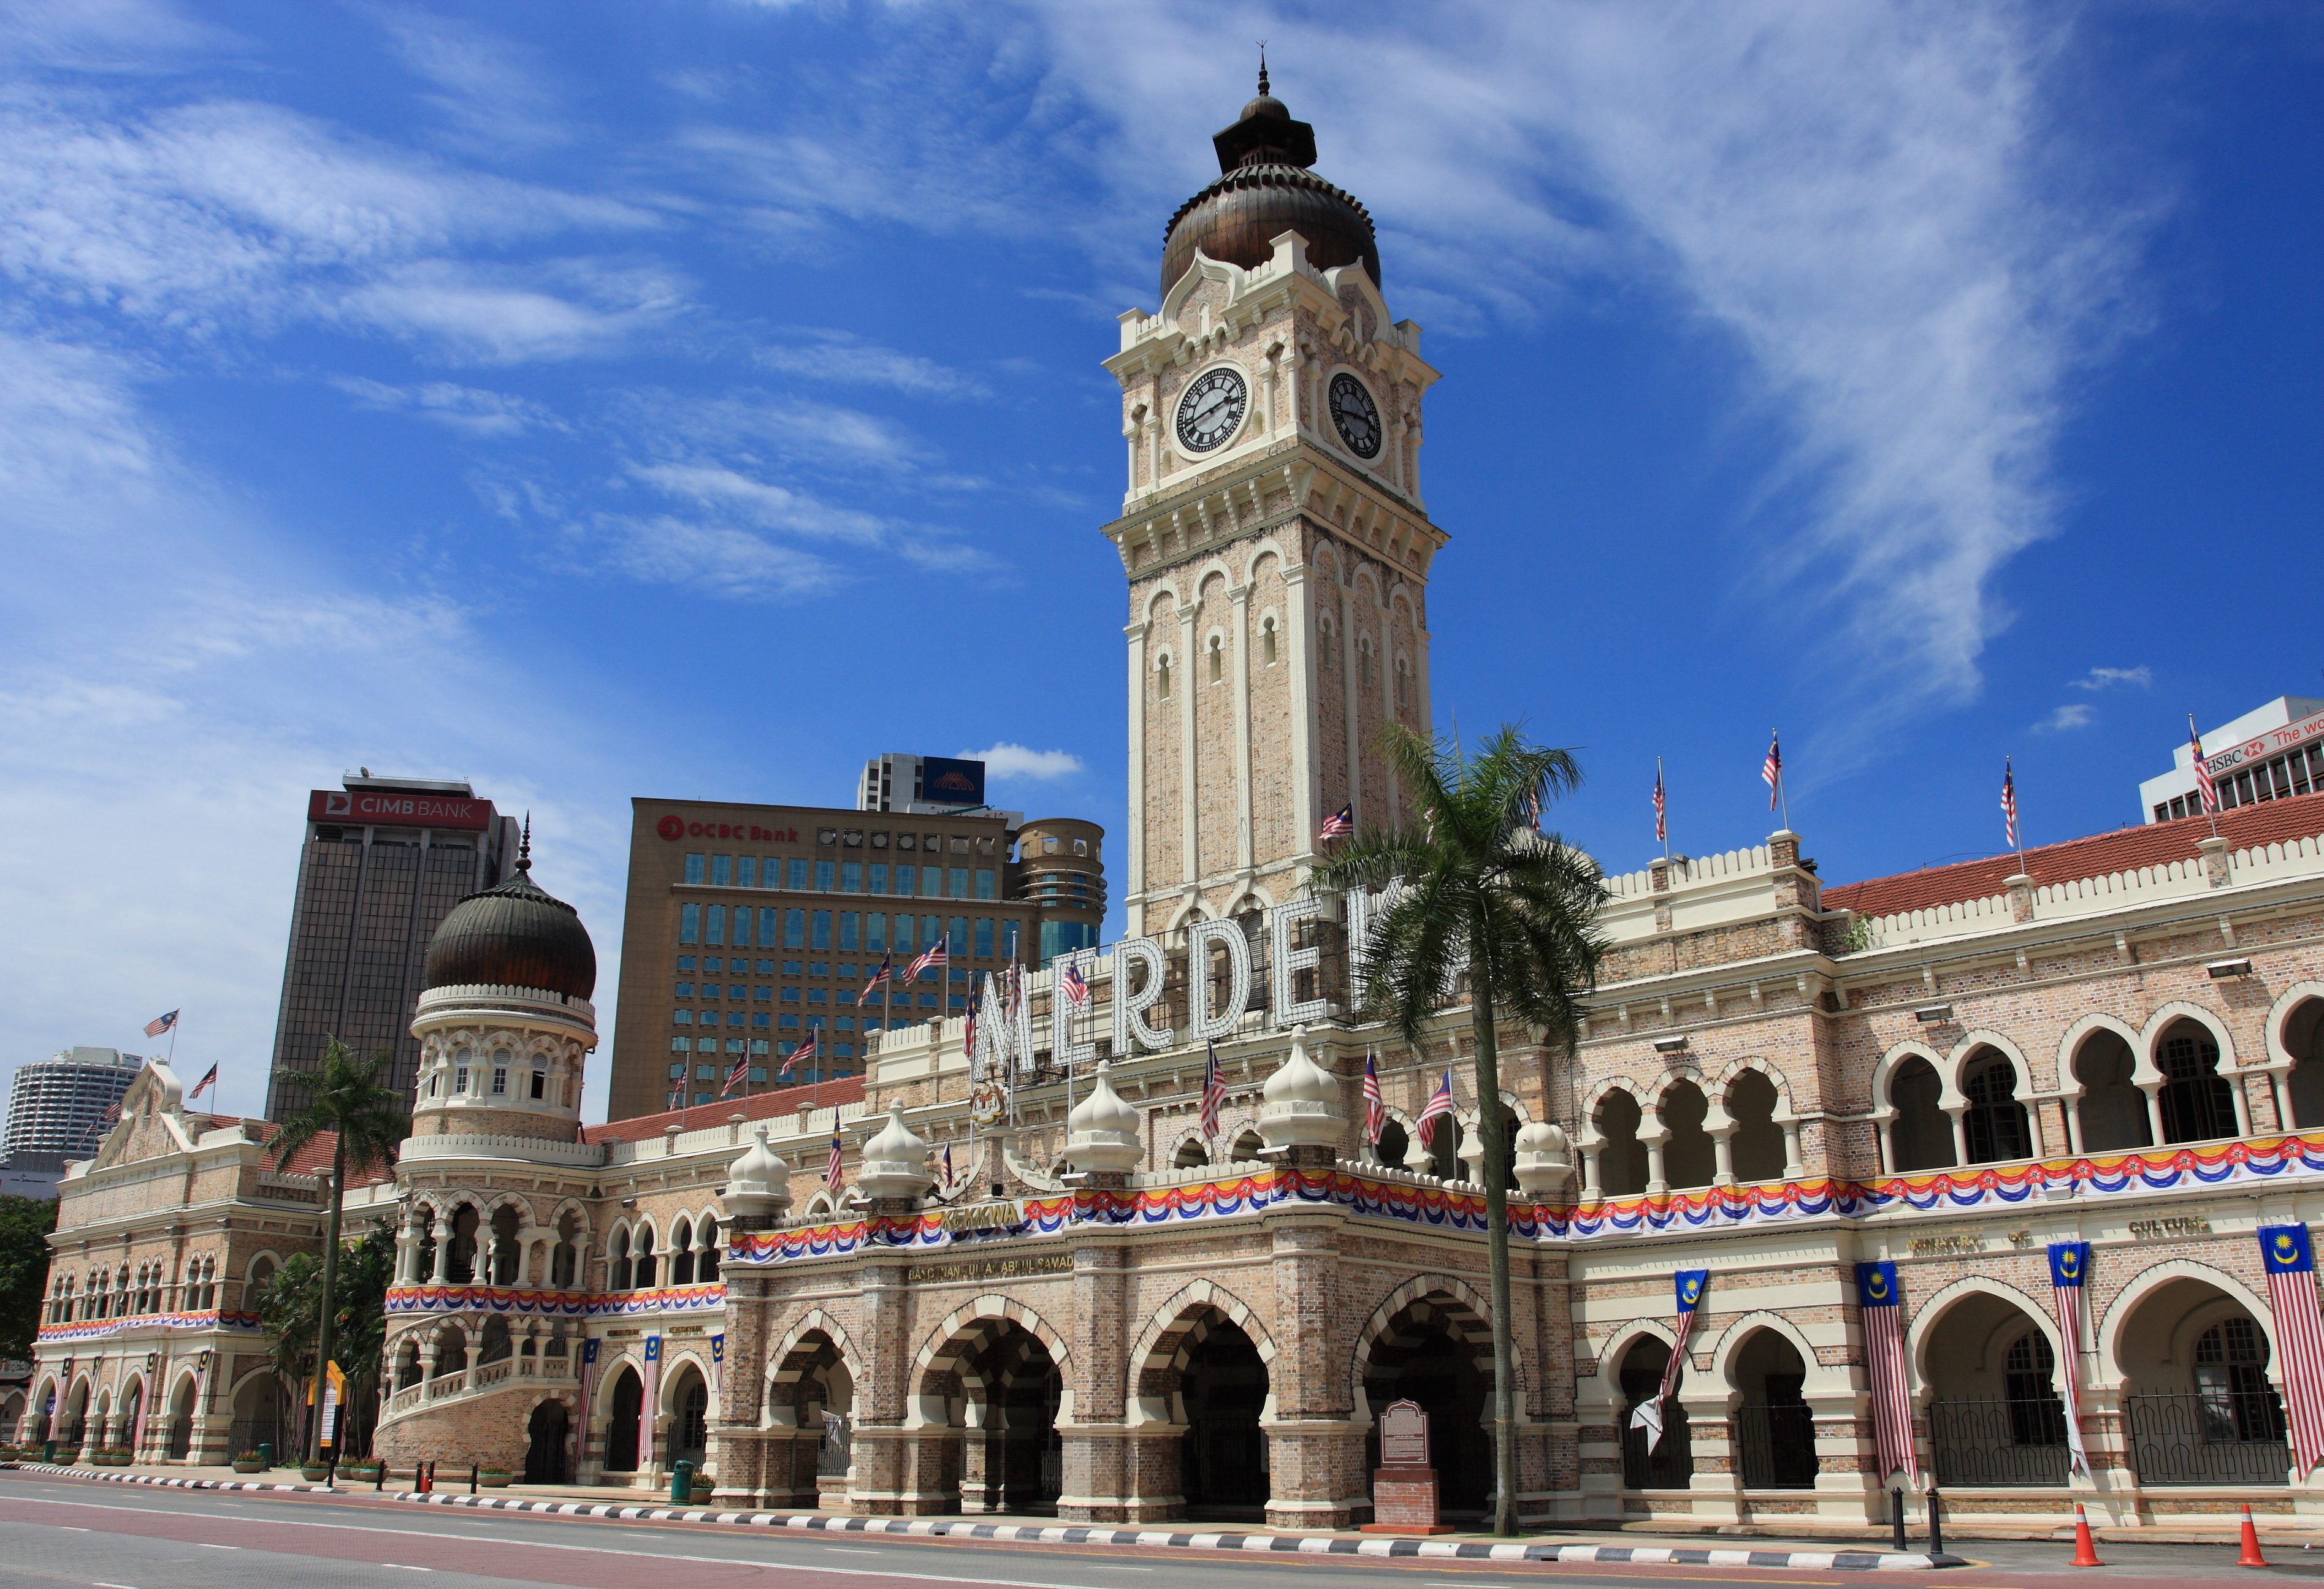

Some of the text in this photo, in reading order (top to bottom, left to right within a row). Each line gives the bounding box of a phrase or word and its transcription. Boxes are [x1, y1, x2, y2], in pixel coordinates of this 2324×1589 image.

[2206, 749, 2242, 774] HSBC
[2273, 728, 2301, 746] The
[360, 798, 473, 818] CIMB BANK
[687, 821, 798, 843] OCBC Bank
[941, 1203, 1019, 1229] KEKKWA
[1907, 1233, 1982, 1251] MINISTRY
[2128, 1216, 2209, 1233] CULTURE
[908, 1265, 961, 1280] BAGNAN
[1037, 1256, 1074, 1270] SAMAD
